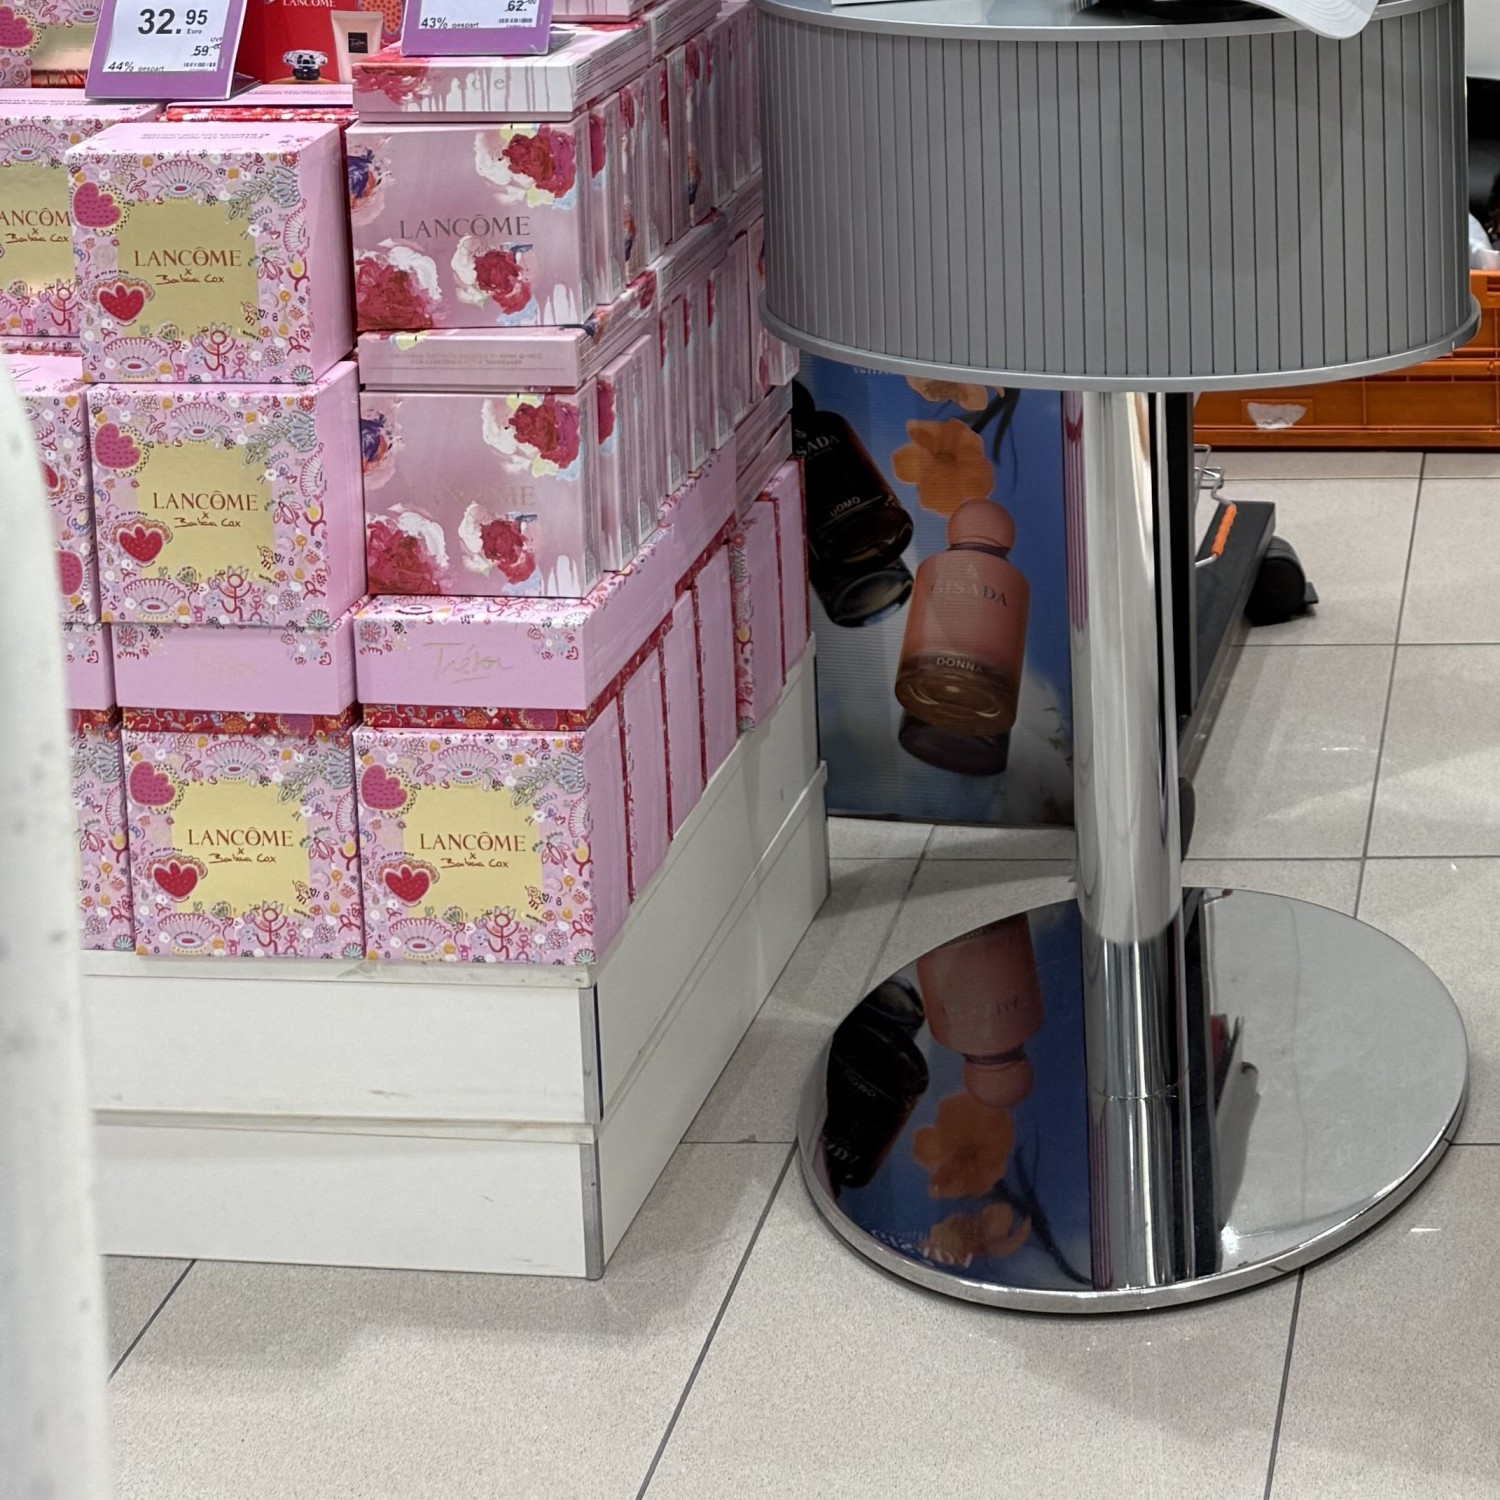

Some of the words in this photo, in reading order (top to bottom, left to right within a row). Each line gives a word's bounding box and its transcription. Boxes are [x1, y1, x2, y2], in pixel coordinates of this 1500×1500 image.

[421, 17, 448, 29] 43%
[0, 206, 72, 227] ANCÔM
[400, 213, 531, 239] LANCÔME
[50, 233, 71, 244] Cox
[133, 247, 243, 267] LANCÔME
[204, 274, 225, 284] Cox
[153, 491, 259, 512] LANCÔME
[829, 496, 861, 518] UOMO
[221, 518, 241, 528] Cox
[930, 581, 1008, 608] GISADA
[936, 656, 984, 673] DONNA
[188, 826, 294, 848] LANCÔME
[420, 831, 526, 853] LANCÔME
[256, 853, 277, 864] Cox
[489, 858, 509, 869] Cox
